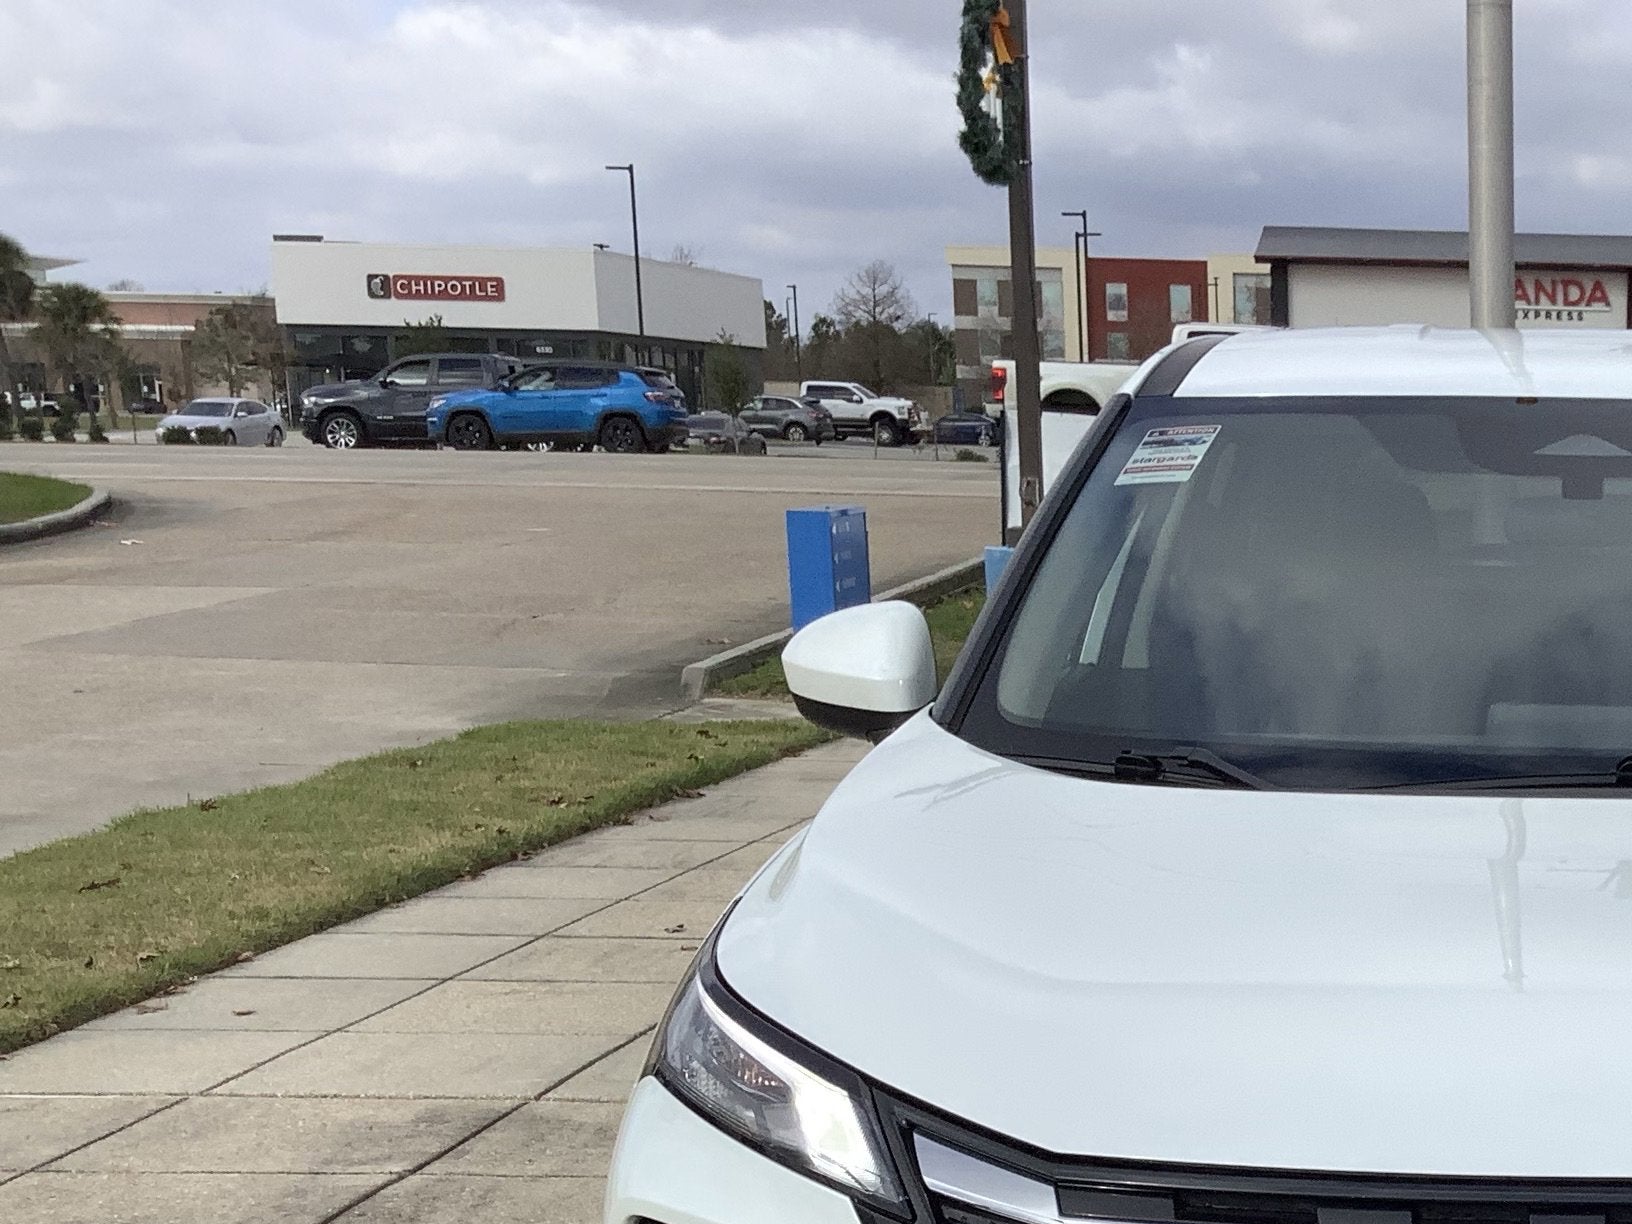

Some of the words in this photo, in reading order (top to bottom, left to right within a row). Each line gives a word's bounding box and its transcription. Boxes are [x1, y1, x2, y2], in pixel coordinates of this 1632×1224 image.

[396, 279, 499, 297] CHIPOTLE
[1515, 278, 1611, 307] ANDA
[1518, 310, 1584, 321] XPRESS
